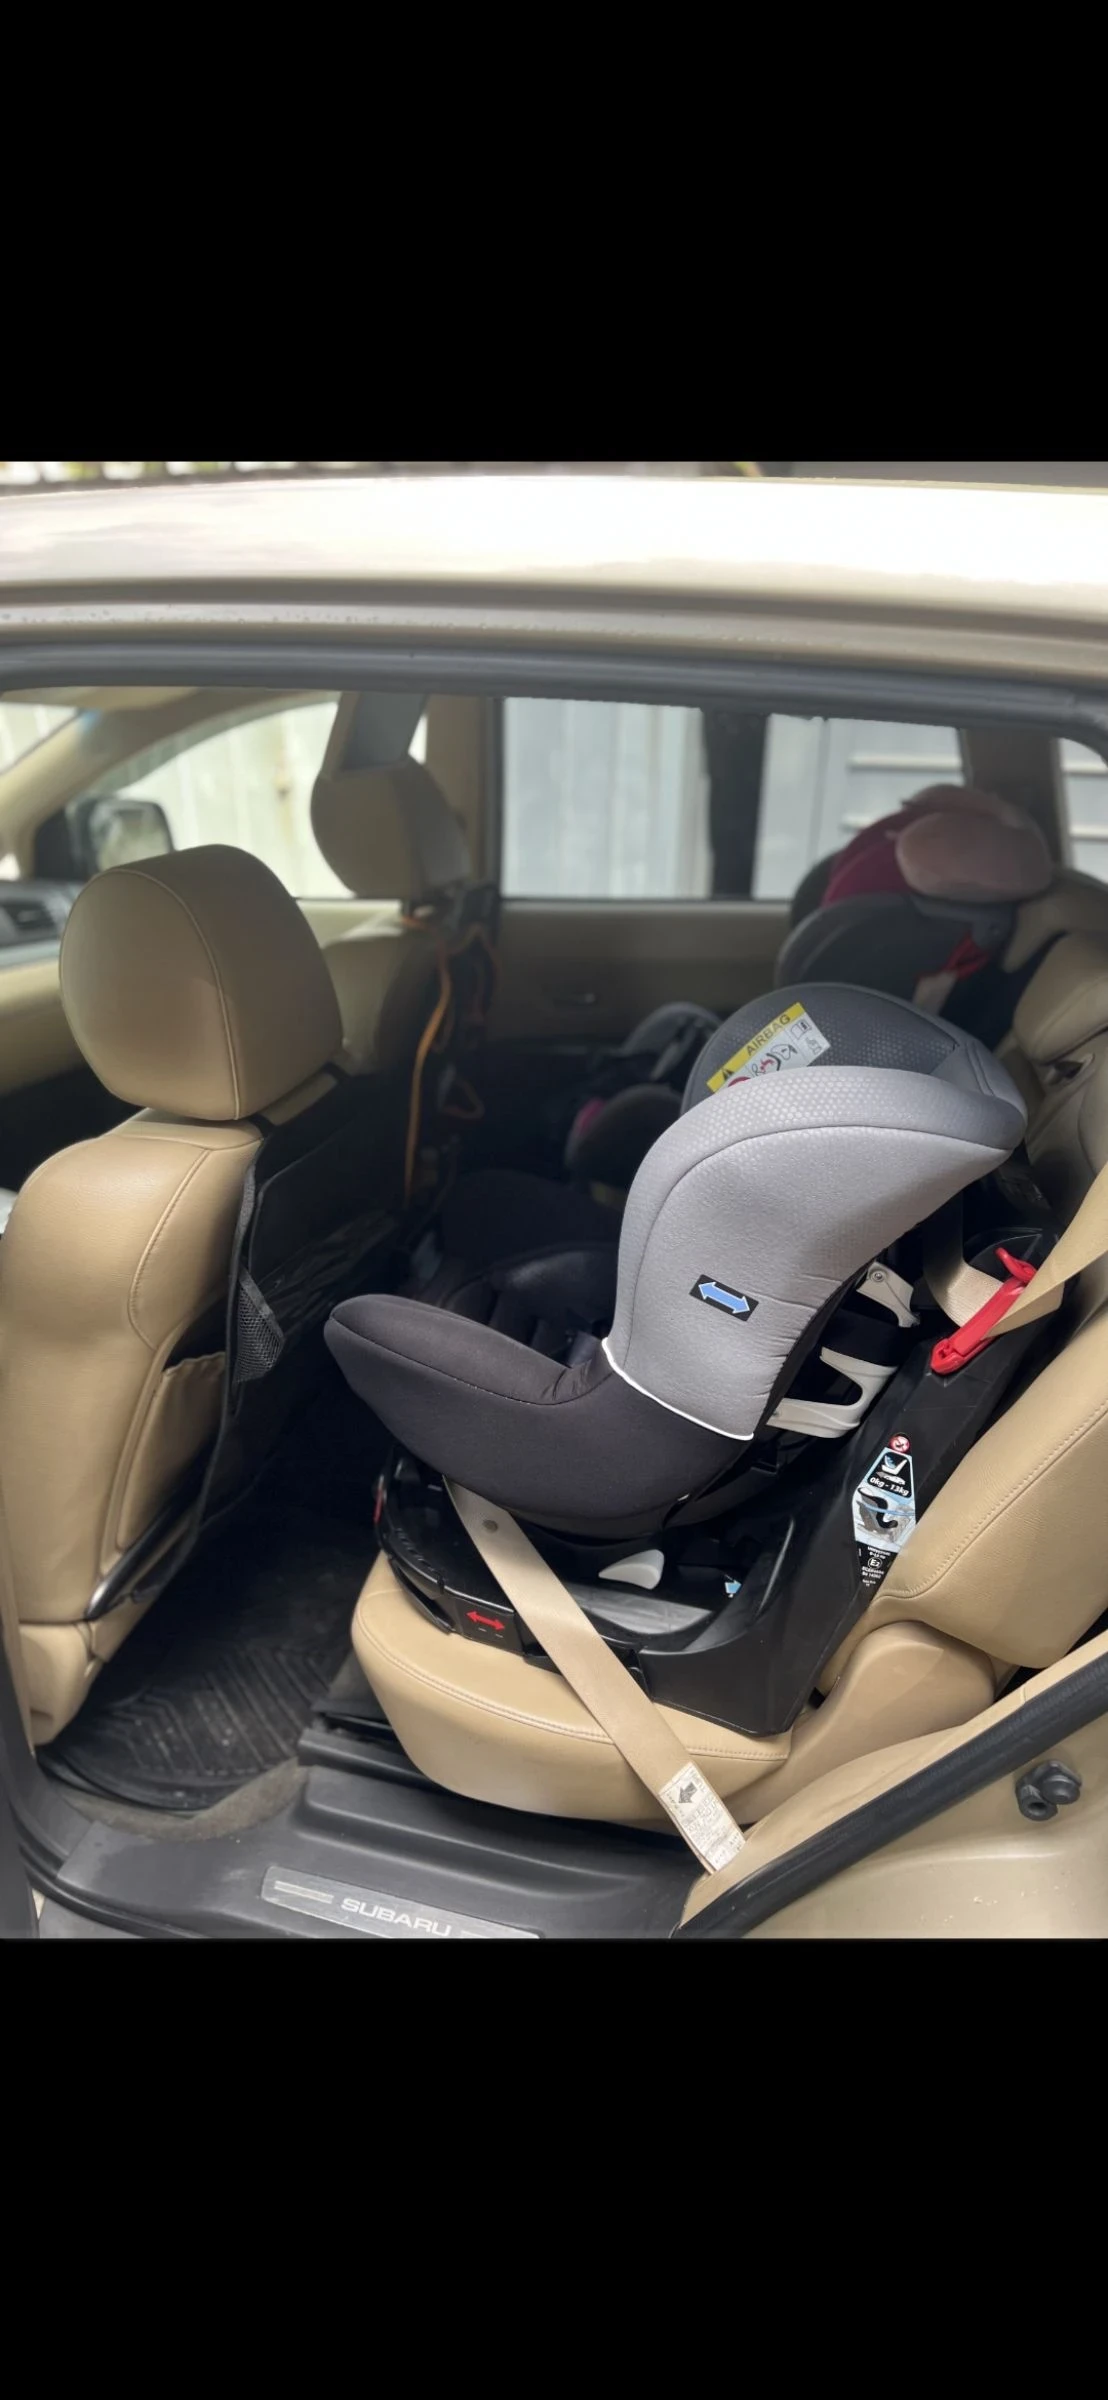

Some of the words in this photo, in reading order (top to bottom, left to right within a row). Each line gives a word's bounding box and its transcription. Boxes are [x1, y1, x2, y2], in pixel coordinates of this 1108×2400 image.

[745, 1014, 791, 1057] AIRBAG
[870, 1477, 885, 1488] 0kg
[890, 1484, 909, 1497] 13kg
[340, 1897, 452, 1937] SUBARU
